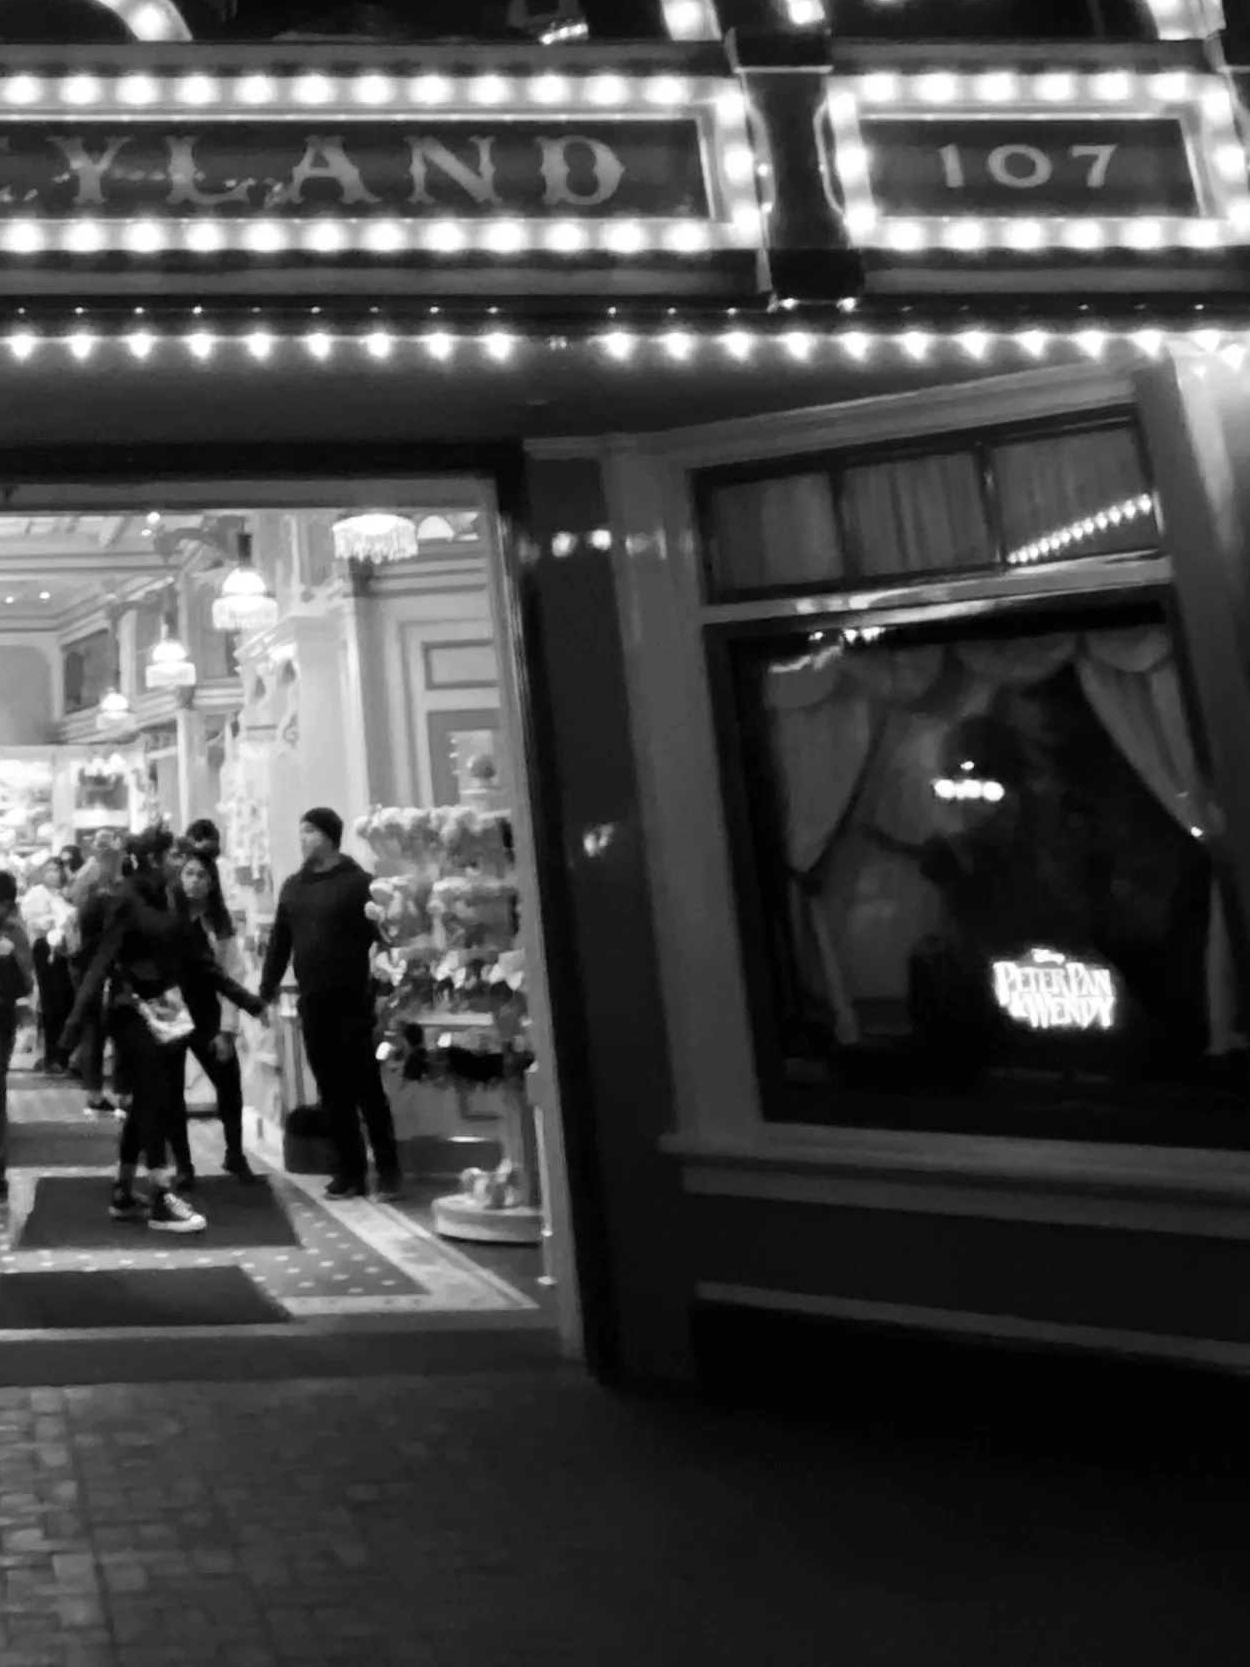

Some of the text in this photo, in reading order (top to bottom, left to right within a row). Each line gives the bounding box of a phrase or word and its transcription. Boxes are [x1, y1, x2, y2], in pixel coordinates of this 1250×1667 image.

[937, 143, 1119, 189] 107
[993, 961, 1113, 1007] PETER PAN
[1023, 993, 1115, 1029] WENDY
